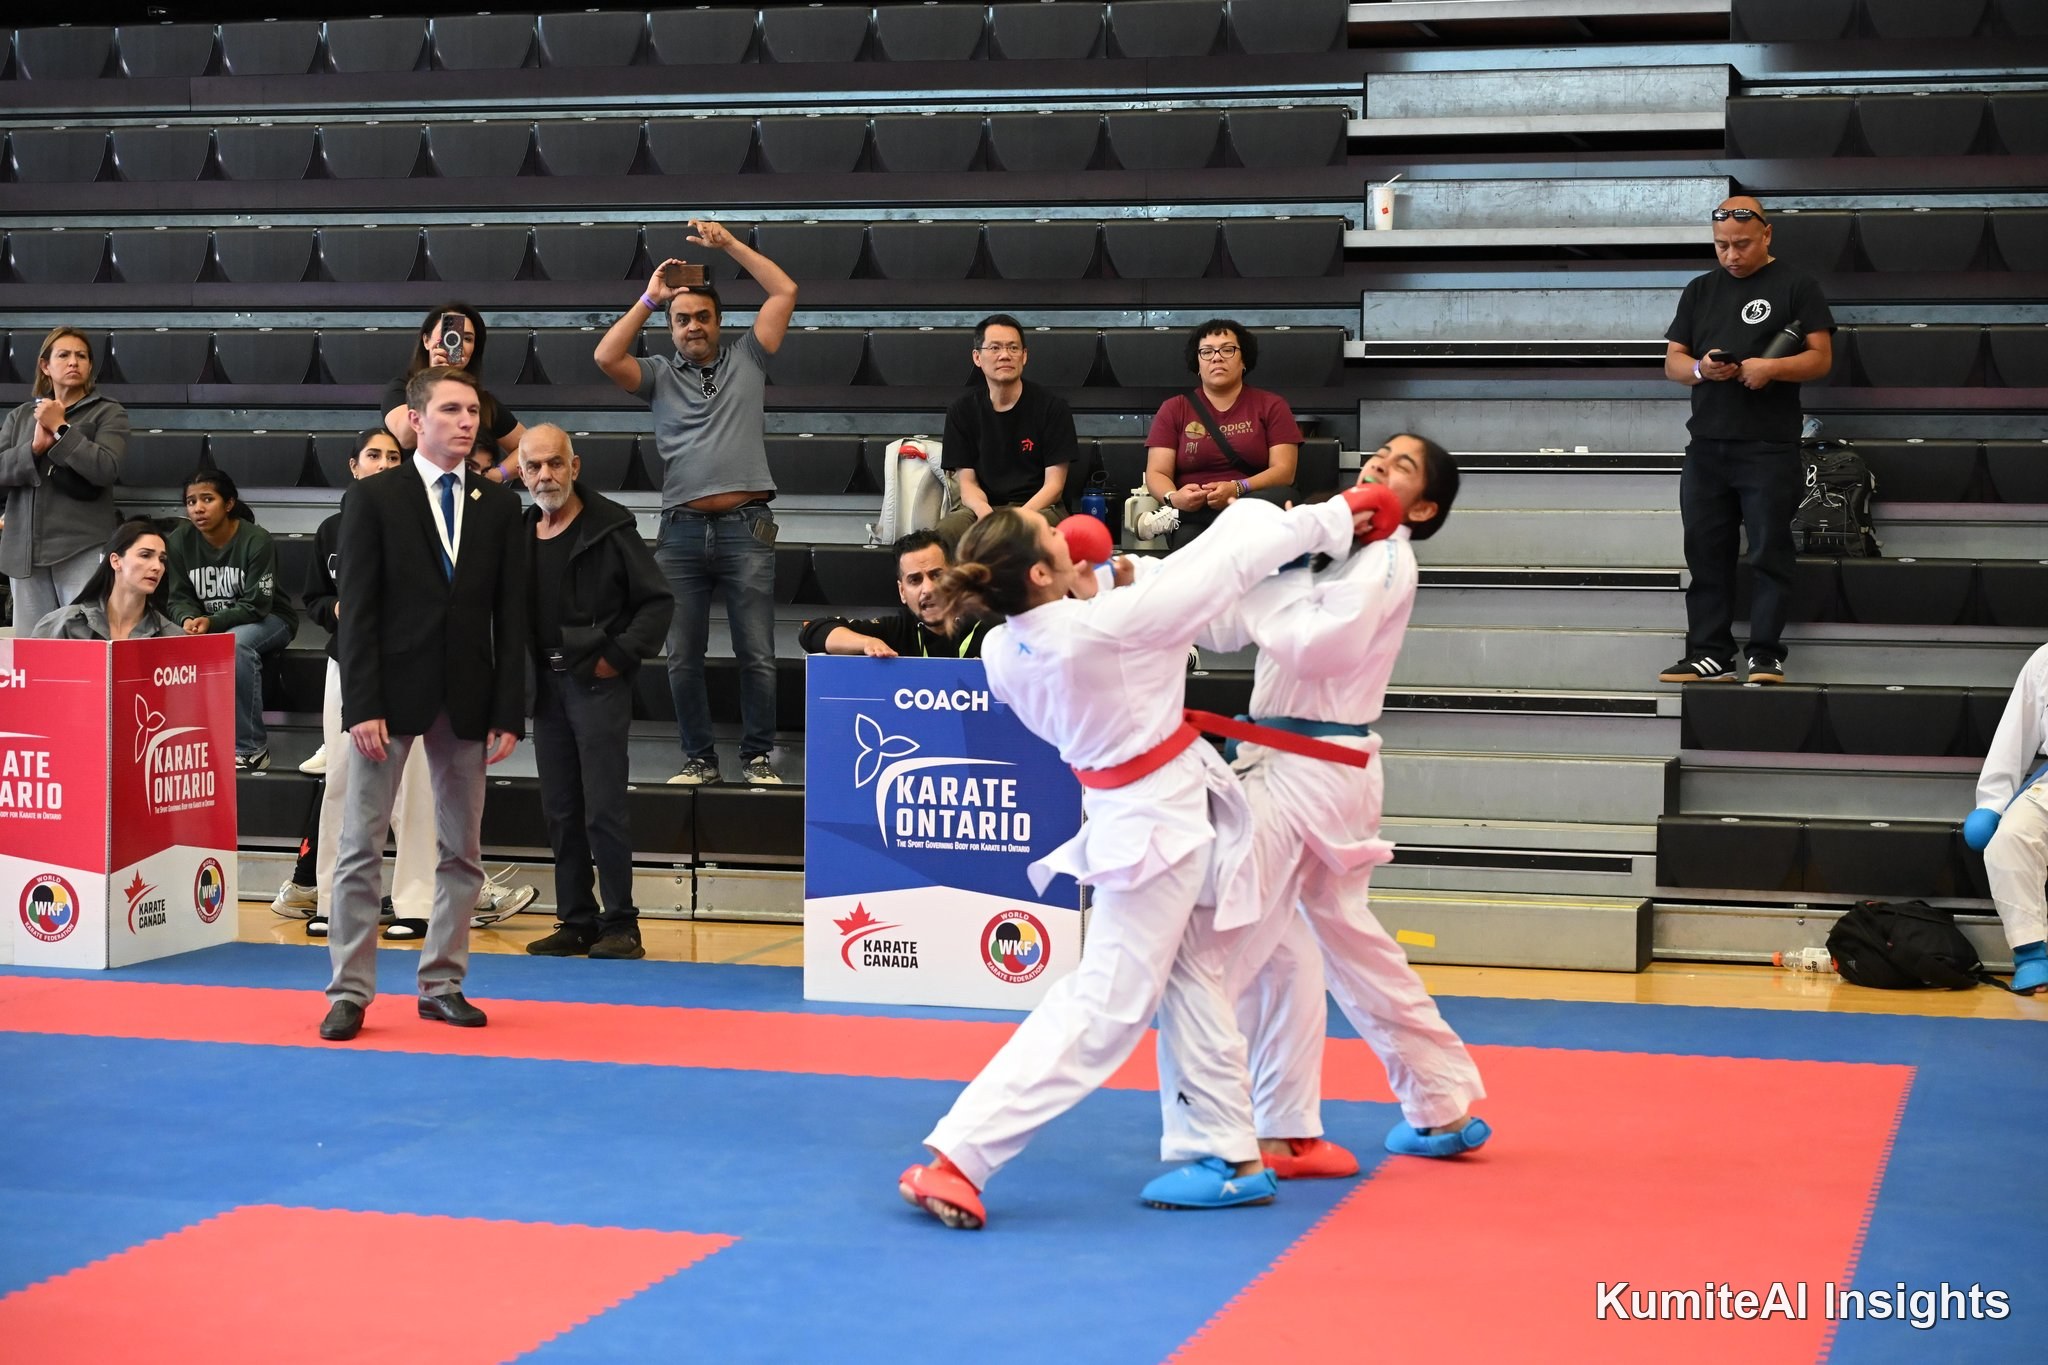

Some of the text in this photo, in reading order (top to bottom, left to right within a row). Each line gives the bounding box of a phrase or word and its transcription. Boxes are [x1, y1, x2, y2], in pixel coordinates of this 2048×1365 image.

[1219, 421, 1252, 433] ODIGY
[154, 664, 197, 687] COACH
[894, 688, 989, 712] COACH
[154, 742, 209, 774] KARATE
[154, 770, 215, 804] ONTARIO
[896, 775, 1017, 808] KARATE
[896, 808, 1031, 842] ONTARIO
[36, 875, 62, 883] WORLD
[202, 884, 217, 900] WKF
[34, 900, 65, 917] WKF
[139, 899, 166, 916] KARATE
[1000, 911, 1030, 920] WORLD
[139, 912, 167, 929] CANADA
[44, 923, 75, 941] FEDERATION
[863, 939, 918, 955] KARATE
[998, 939, 1032, 956] WKF
[863, 953, 919, 969] CANADA
[986, 961, 1045, 983] KARATE FEDERATION
